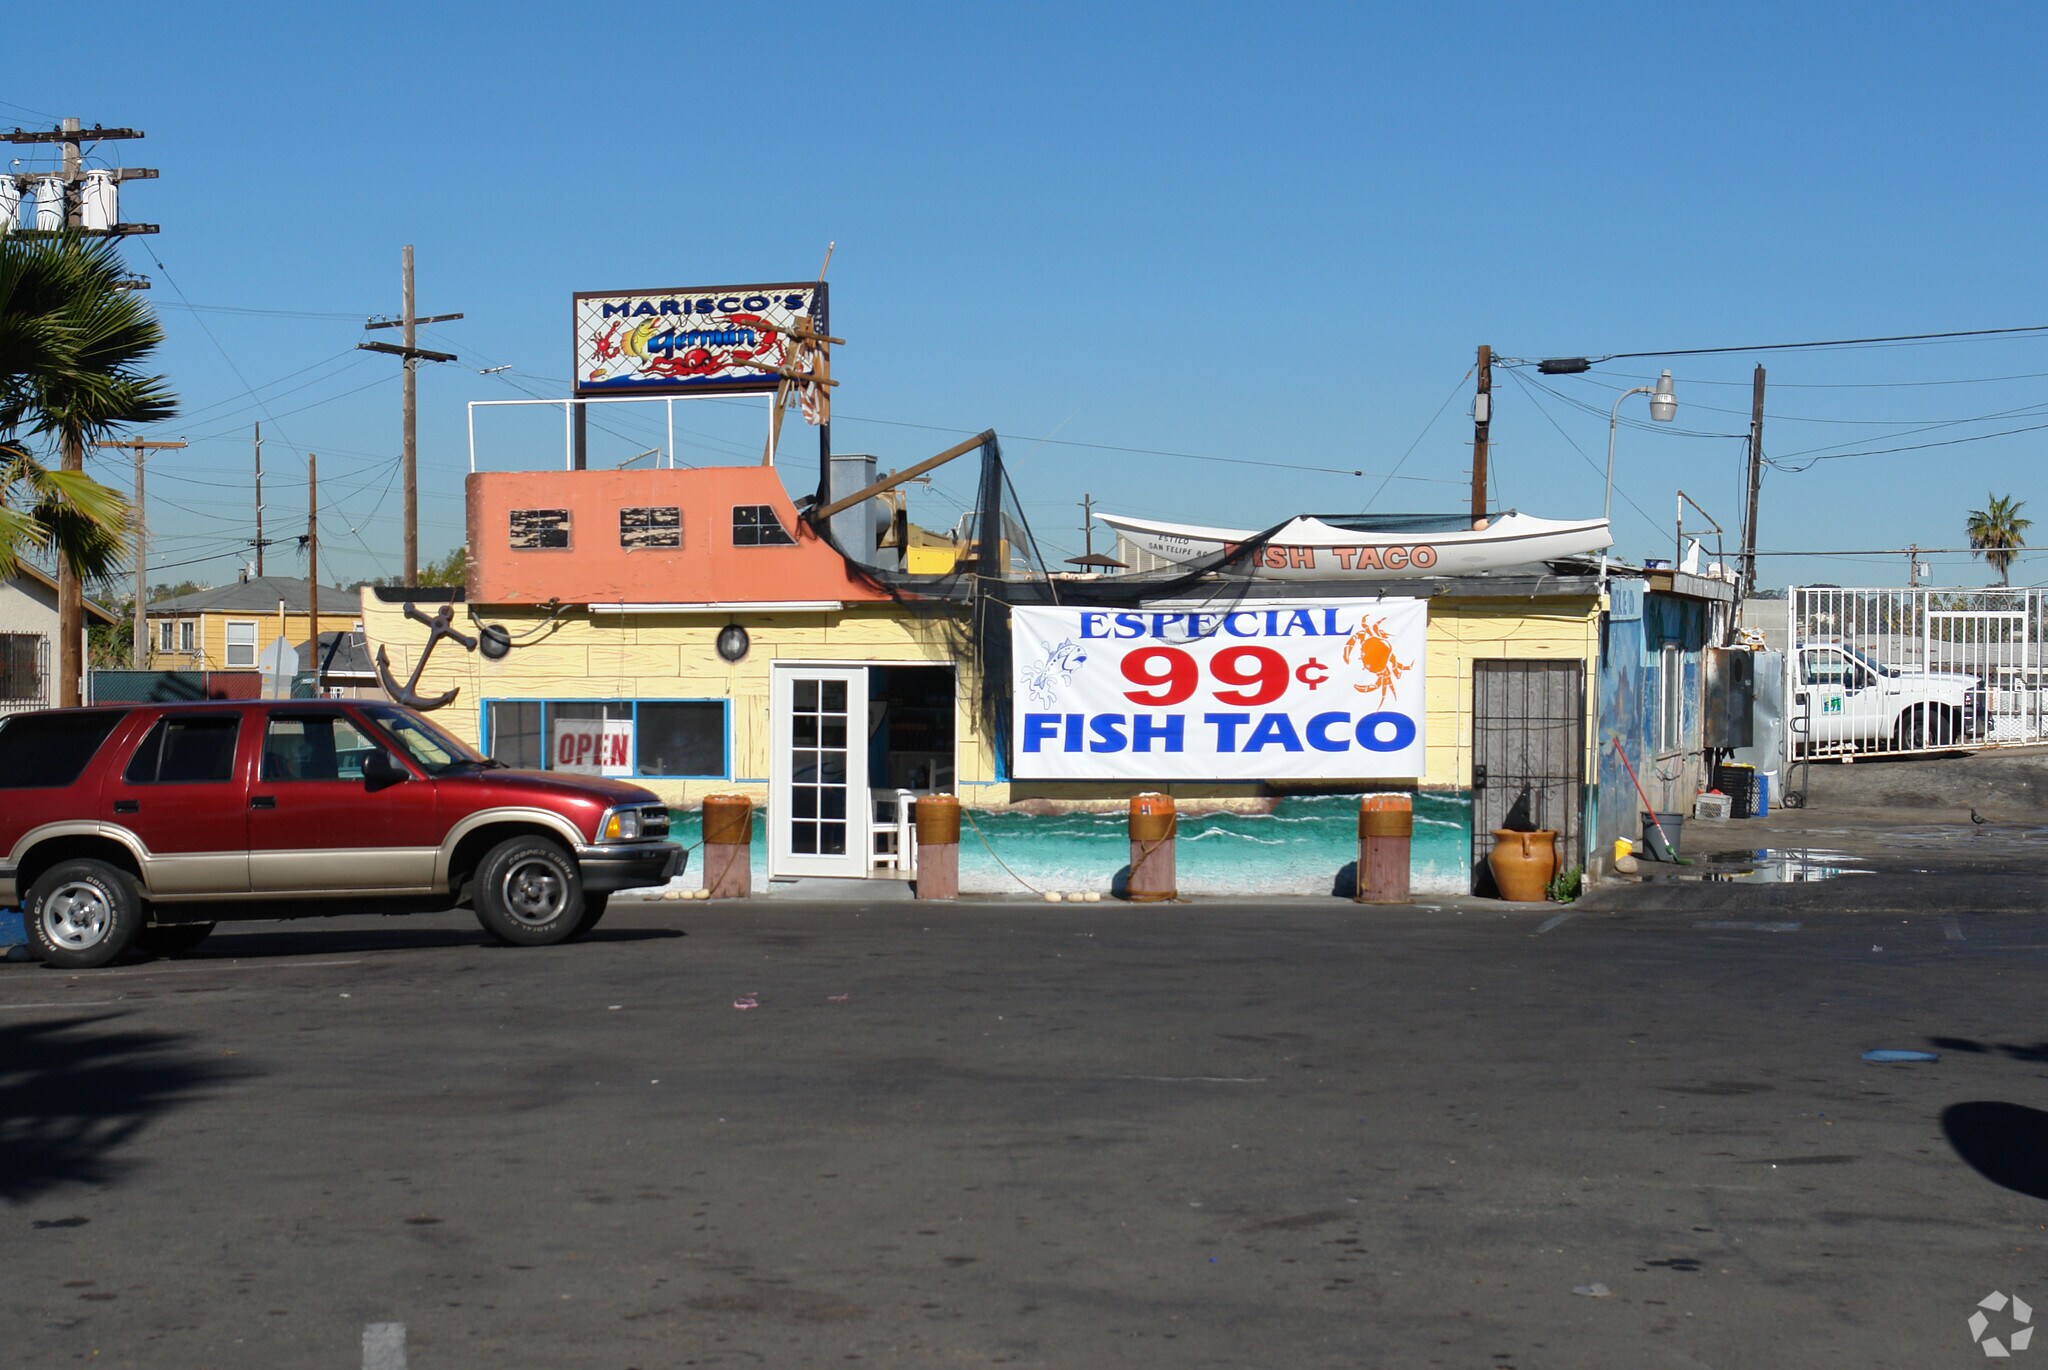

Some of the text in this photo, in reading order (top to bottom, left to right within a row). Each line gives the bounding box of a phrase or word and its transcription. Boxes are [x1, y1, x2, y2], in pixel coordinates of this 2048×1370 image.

[603, 294, 804, 318] MARISCO'S
[1148, 542, 1164, 551] SAN
[1166, 545, 1192, 556] FELIPE
[1158, 534, 1189, 545] ESTILO
[1223, 542, 1438, 570] FISH TACO
[1079, 608, 1354, 640] ESPECIAL
[1022, 711, 1417, 753] FISH TACO
[558, 732, 629, 767] OPEN
